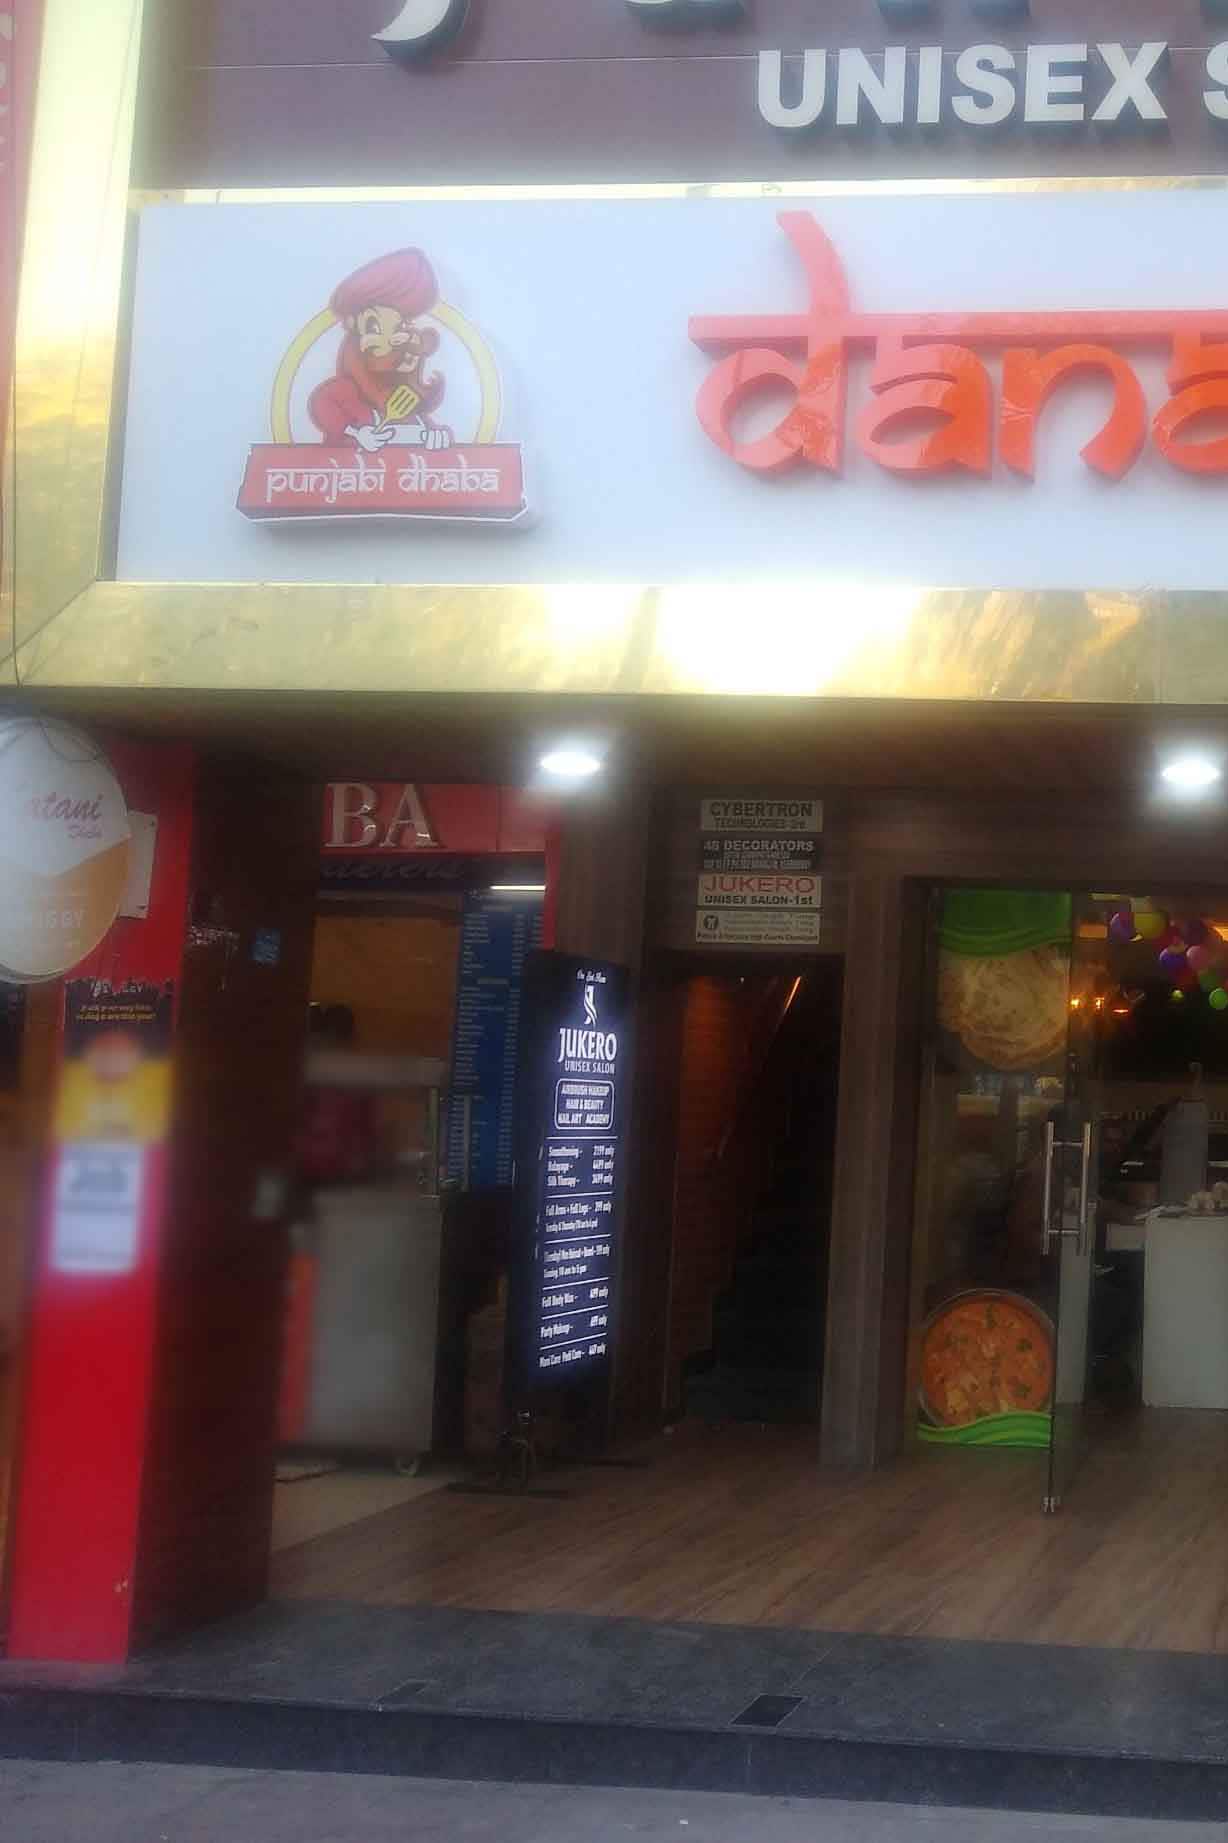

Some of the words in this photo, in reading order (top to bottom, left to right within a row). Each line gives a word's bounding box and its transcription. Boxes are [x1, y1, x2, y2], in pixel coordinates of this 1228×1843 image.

[757, 42, 1168, 129] UNISEX
[265, 450, 387, 503] punjabi
[397, 453, 500, 493] dhaba
[711, 801, 812, 817] CYBERTRON
[724, 840, 815, 852] DECORATORS
[704, 876, 816, 893] JUKERO
[704, 895, 746, 905] UNISEX
[558, 1028, 617, 1063] JUKERO
[564, 1060, 591, 1073] UNISEX
[592, 1062, 616, 1074] SALON
